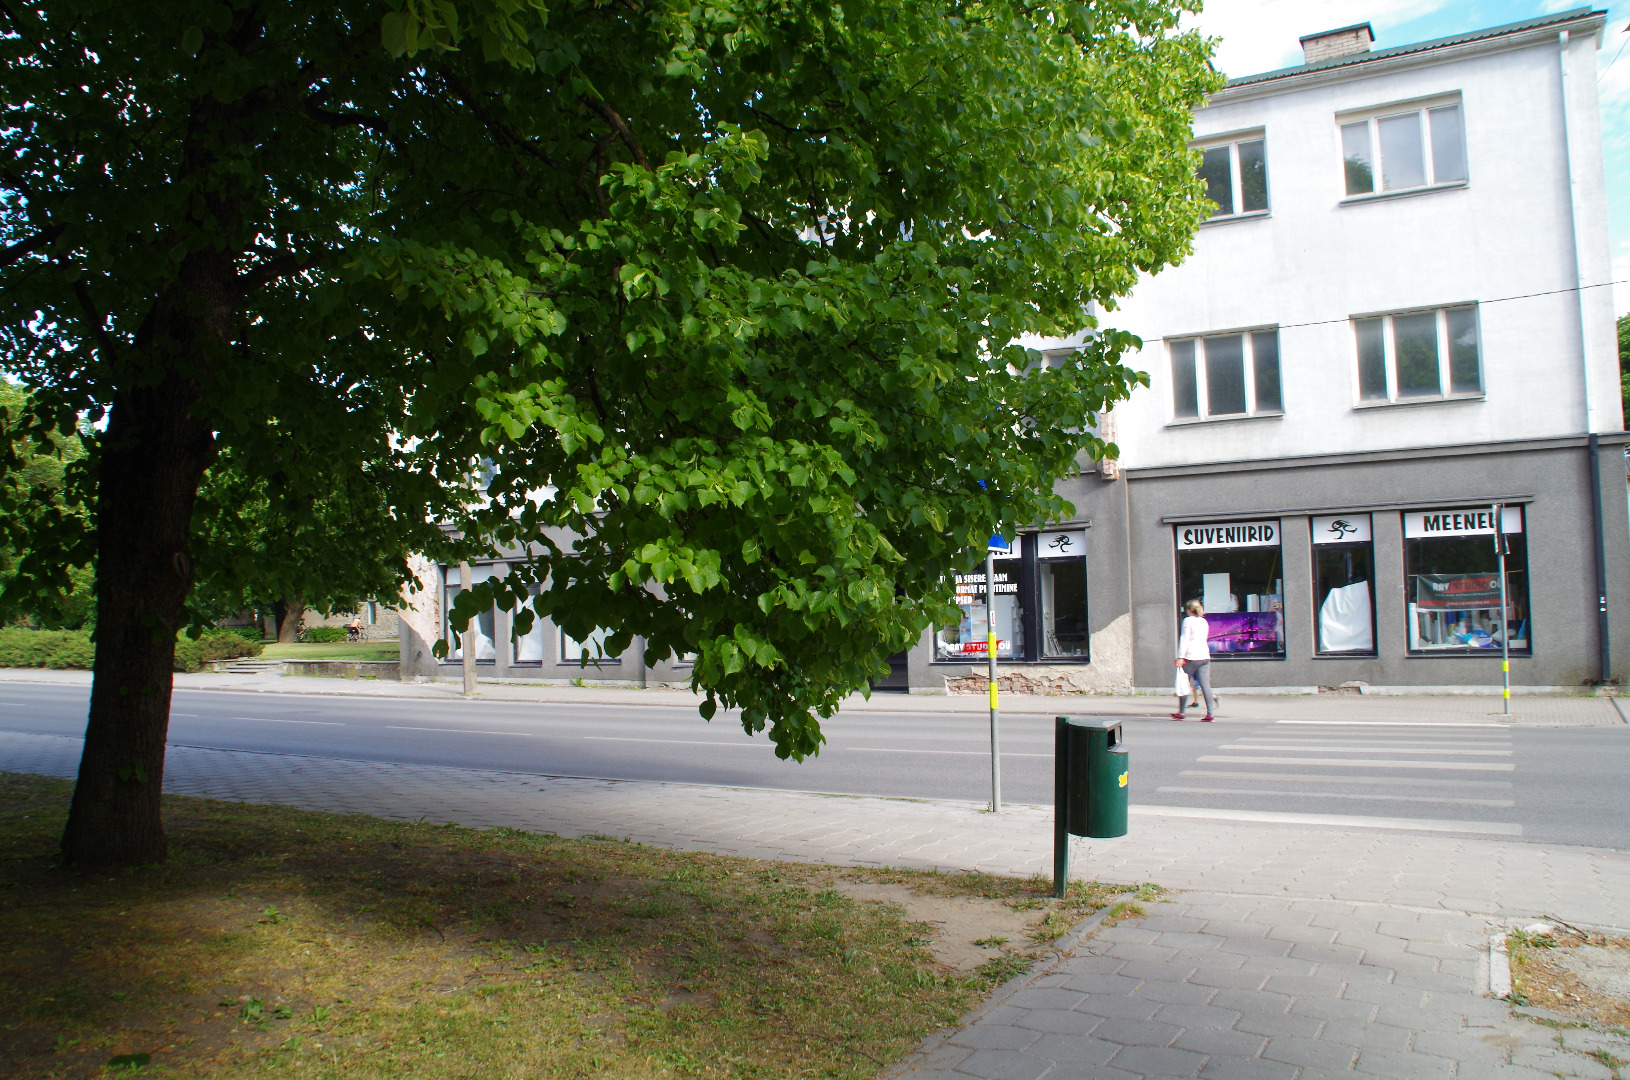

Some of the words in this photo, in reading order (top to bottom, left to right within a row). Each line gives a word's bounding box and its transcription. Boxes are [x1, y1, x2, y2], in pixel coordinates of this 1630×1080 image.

[1183, 525, 1274, 545] SUVENIIRID
[963, 573, 1008, 583] SISEREAAM
[1452, 581, 1489, 590] STUDIO
